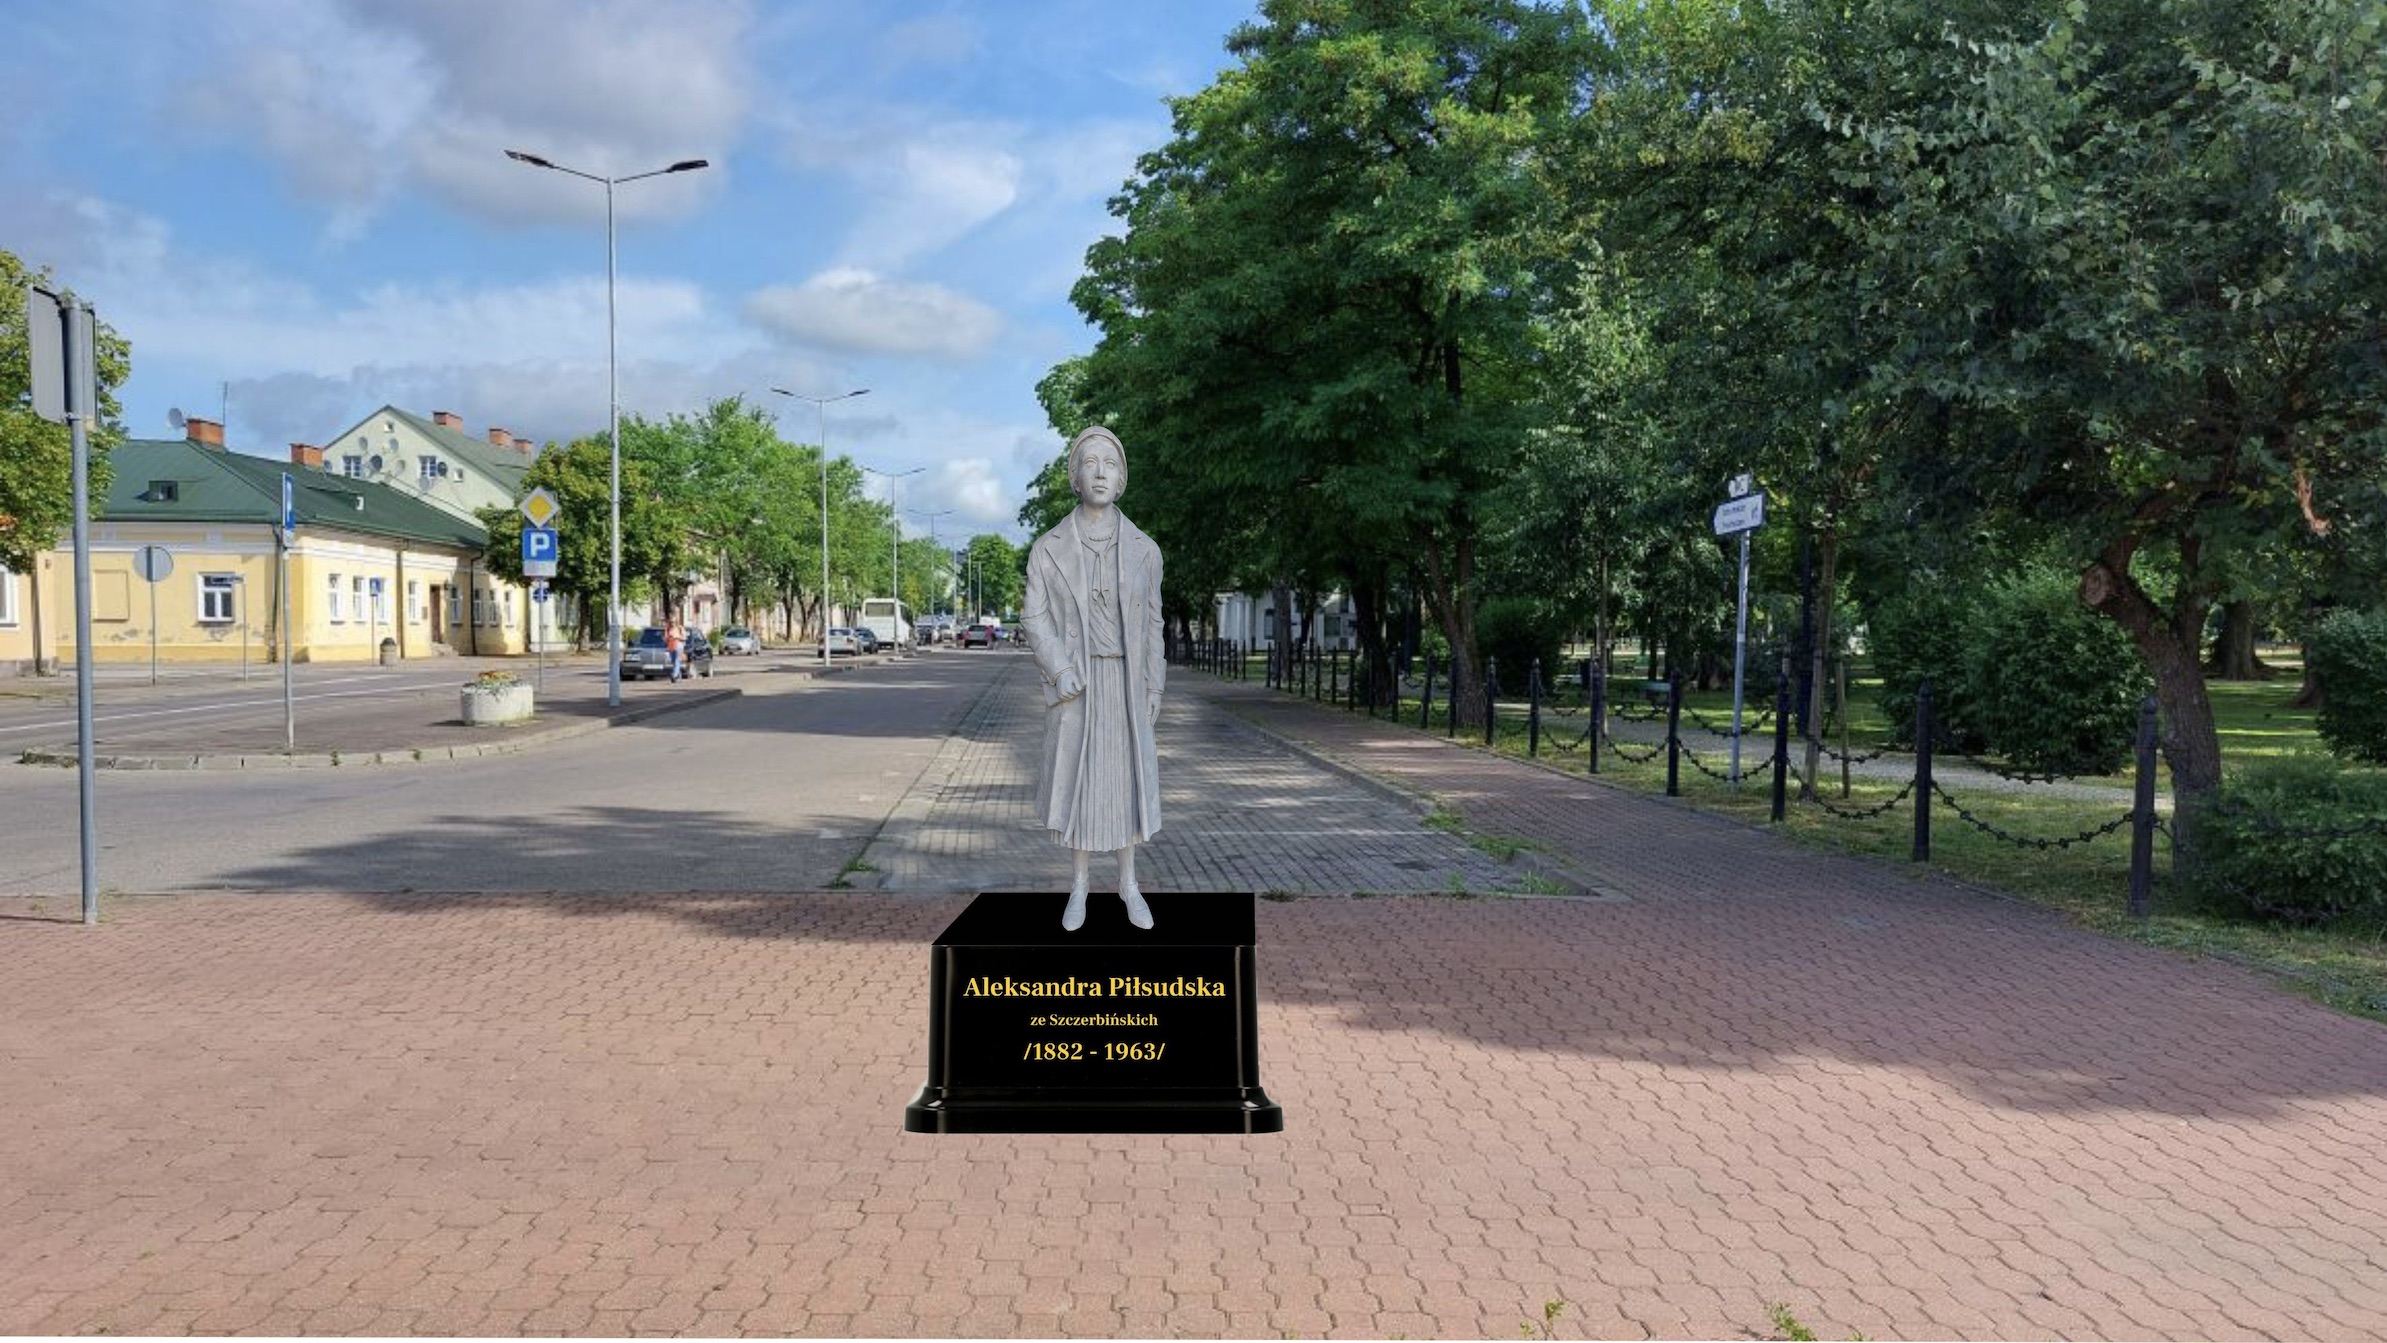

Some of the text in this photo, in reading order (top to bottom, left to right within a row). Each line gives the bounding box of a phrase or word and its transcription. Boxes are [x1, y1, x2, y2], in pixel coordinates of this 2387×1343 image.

[530, 532, 550, 558] P
[963, 976, 1226, 998] Aleksandra Piłsudska
[1030, 1013, 1158, 1026] ze Szczerbińskich
[1023, 1043, 1083, 1061] /1882
[1104, 1043, 1165, 1061] 1963/
